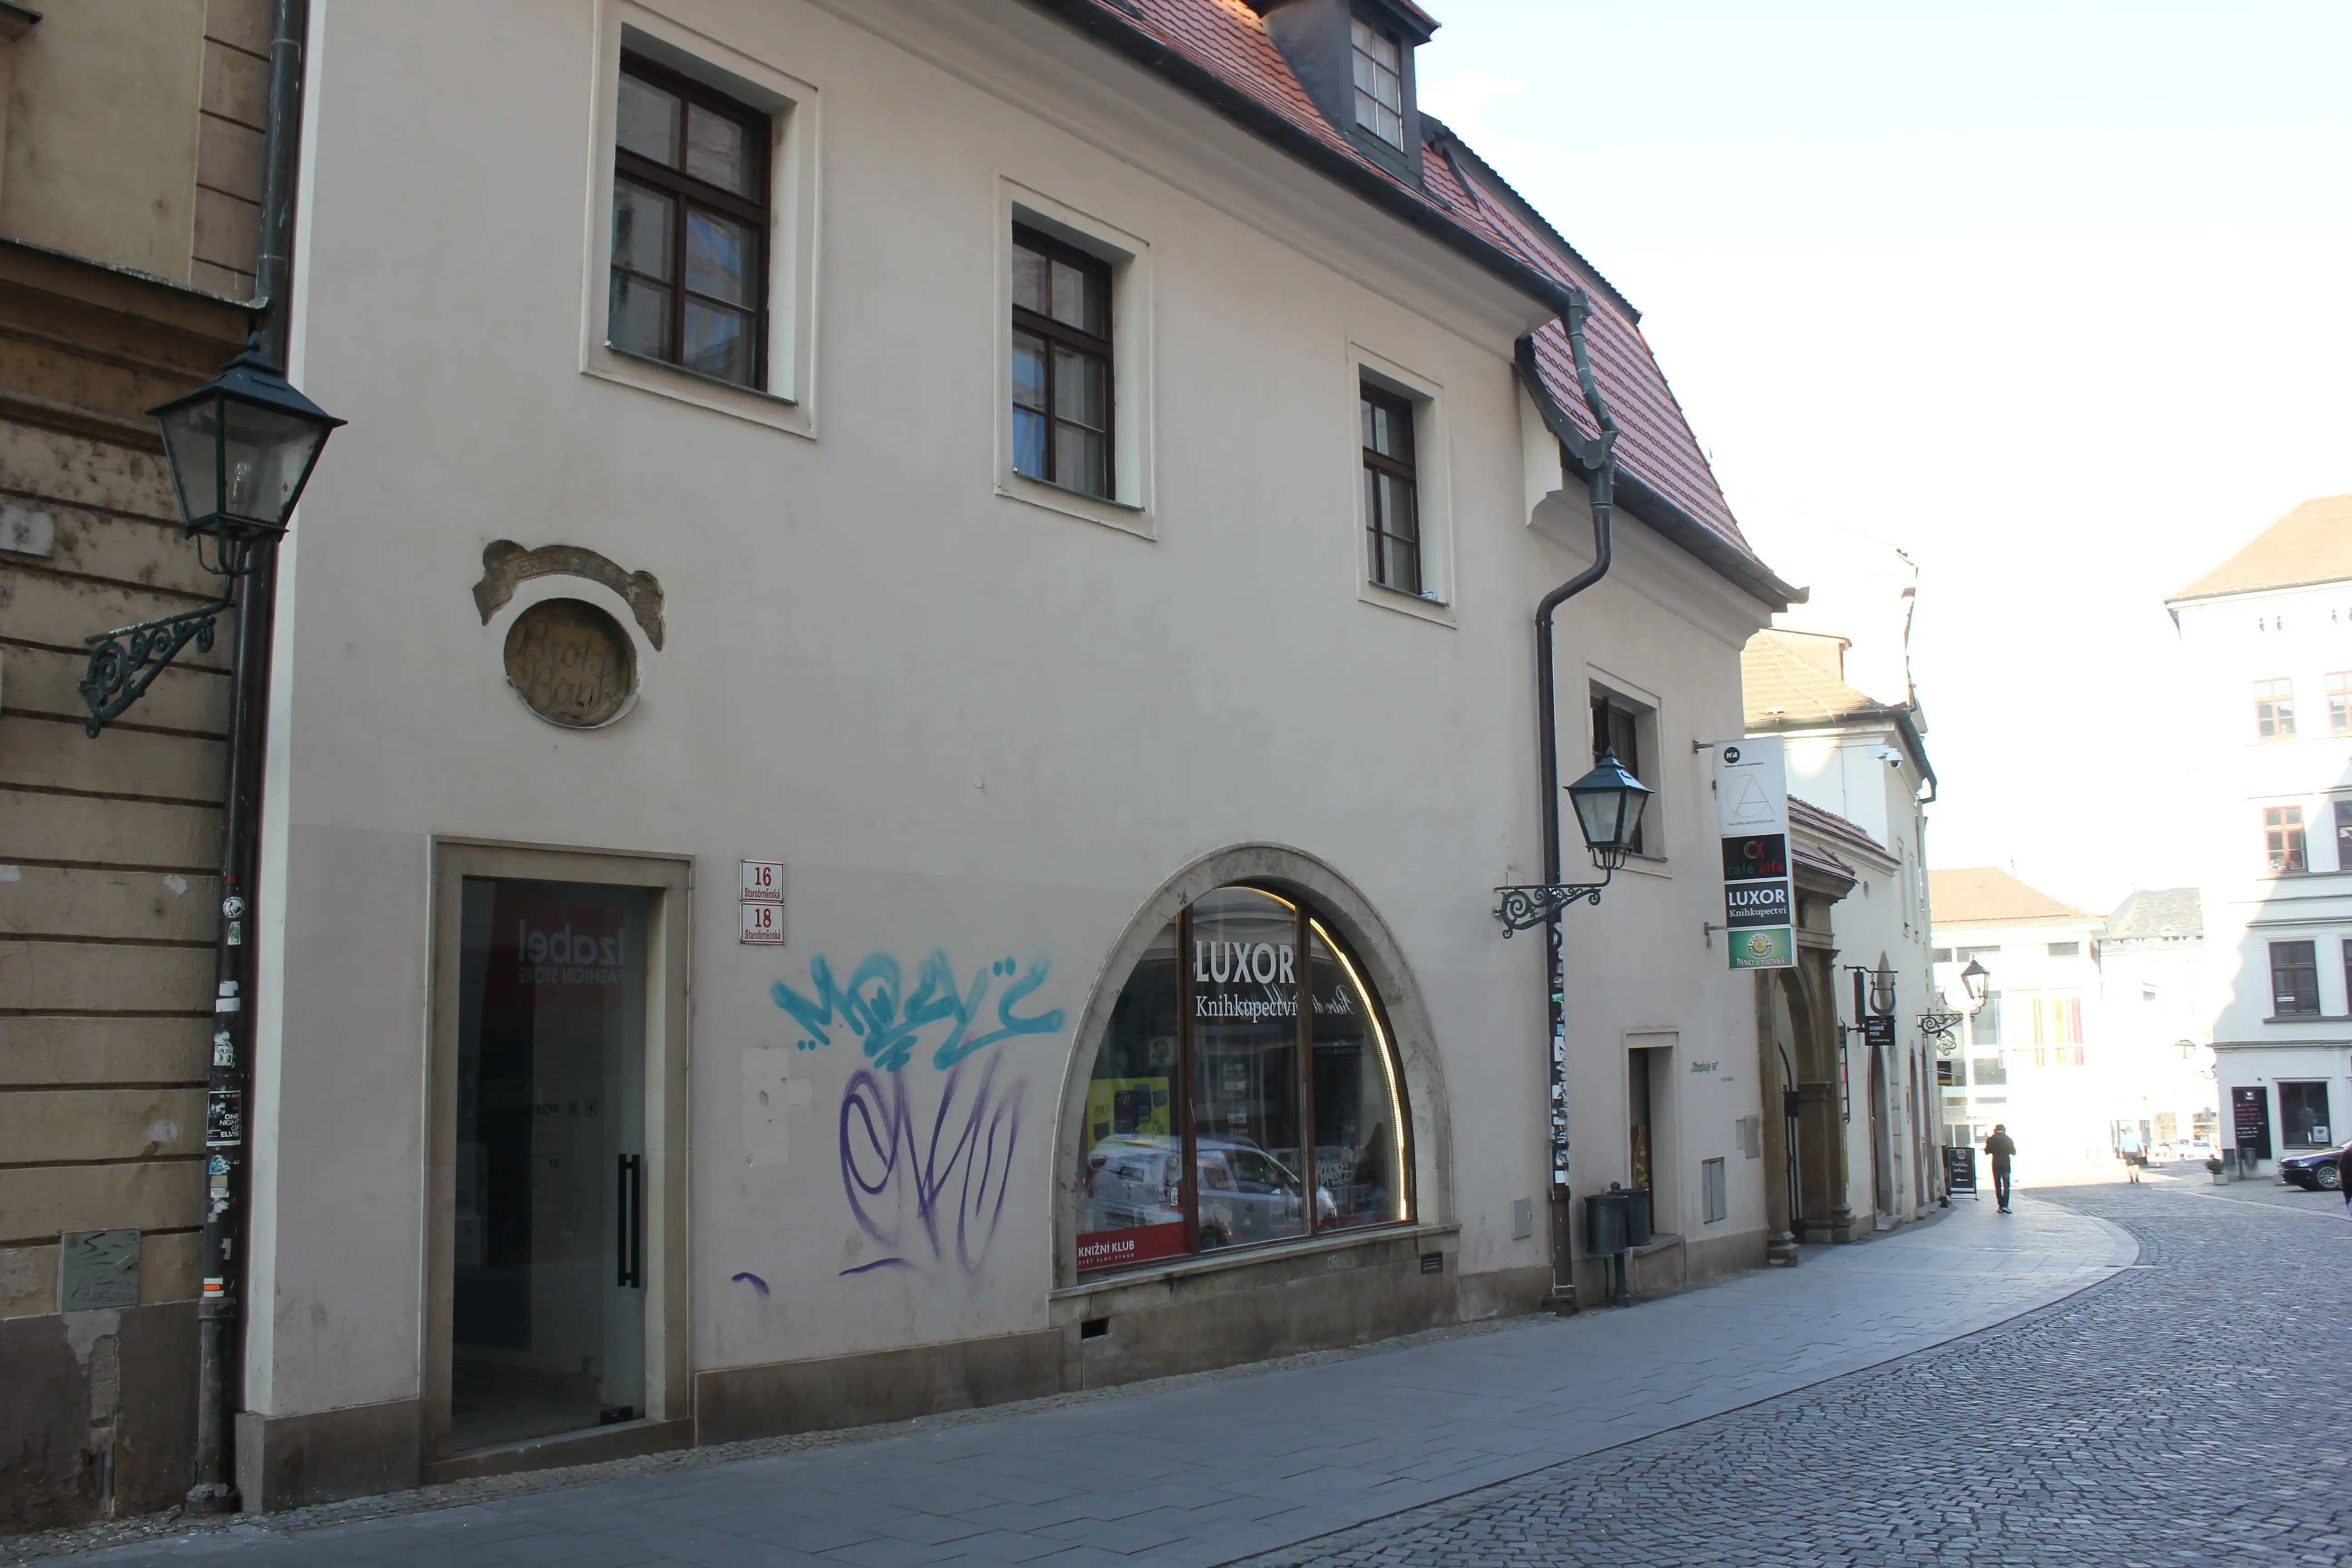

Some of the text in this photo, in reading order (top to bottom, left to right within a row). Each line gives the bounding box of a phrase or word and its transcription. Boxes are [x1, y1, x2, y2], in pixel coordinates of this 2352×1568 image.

[755, 867, 771, 887] 16
[1727, 860, 1785, 876] café alfa
[744, 887, 780, 899] Starobrněnská
[1728, 888, 1786, 906] LUXOR
[755, 908, 771, 928] 18
[1729, 906, 1788, 917] Knihkupectví
[745, 929, 781, 941] Starobrněnská
[1195, 940, 1296, 984] LUXOR
[1736, 958, 1755, 967] PIVNICE
[1195, 994, 1297, 1024] Knihkupectví
[1078, 1240, 1135, 1258] KNIŽNÍ KLUB
